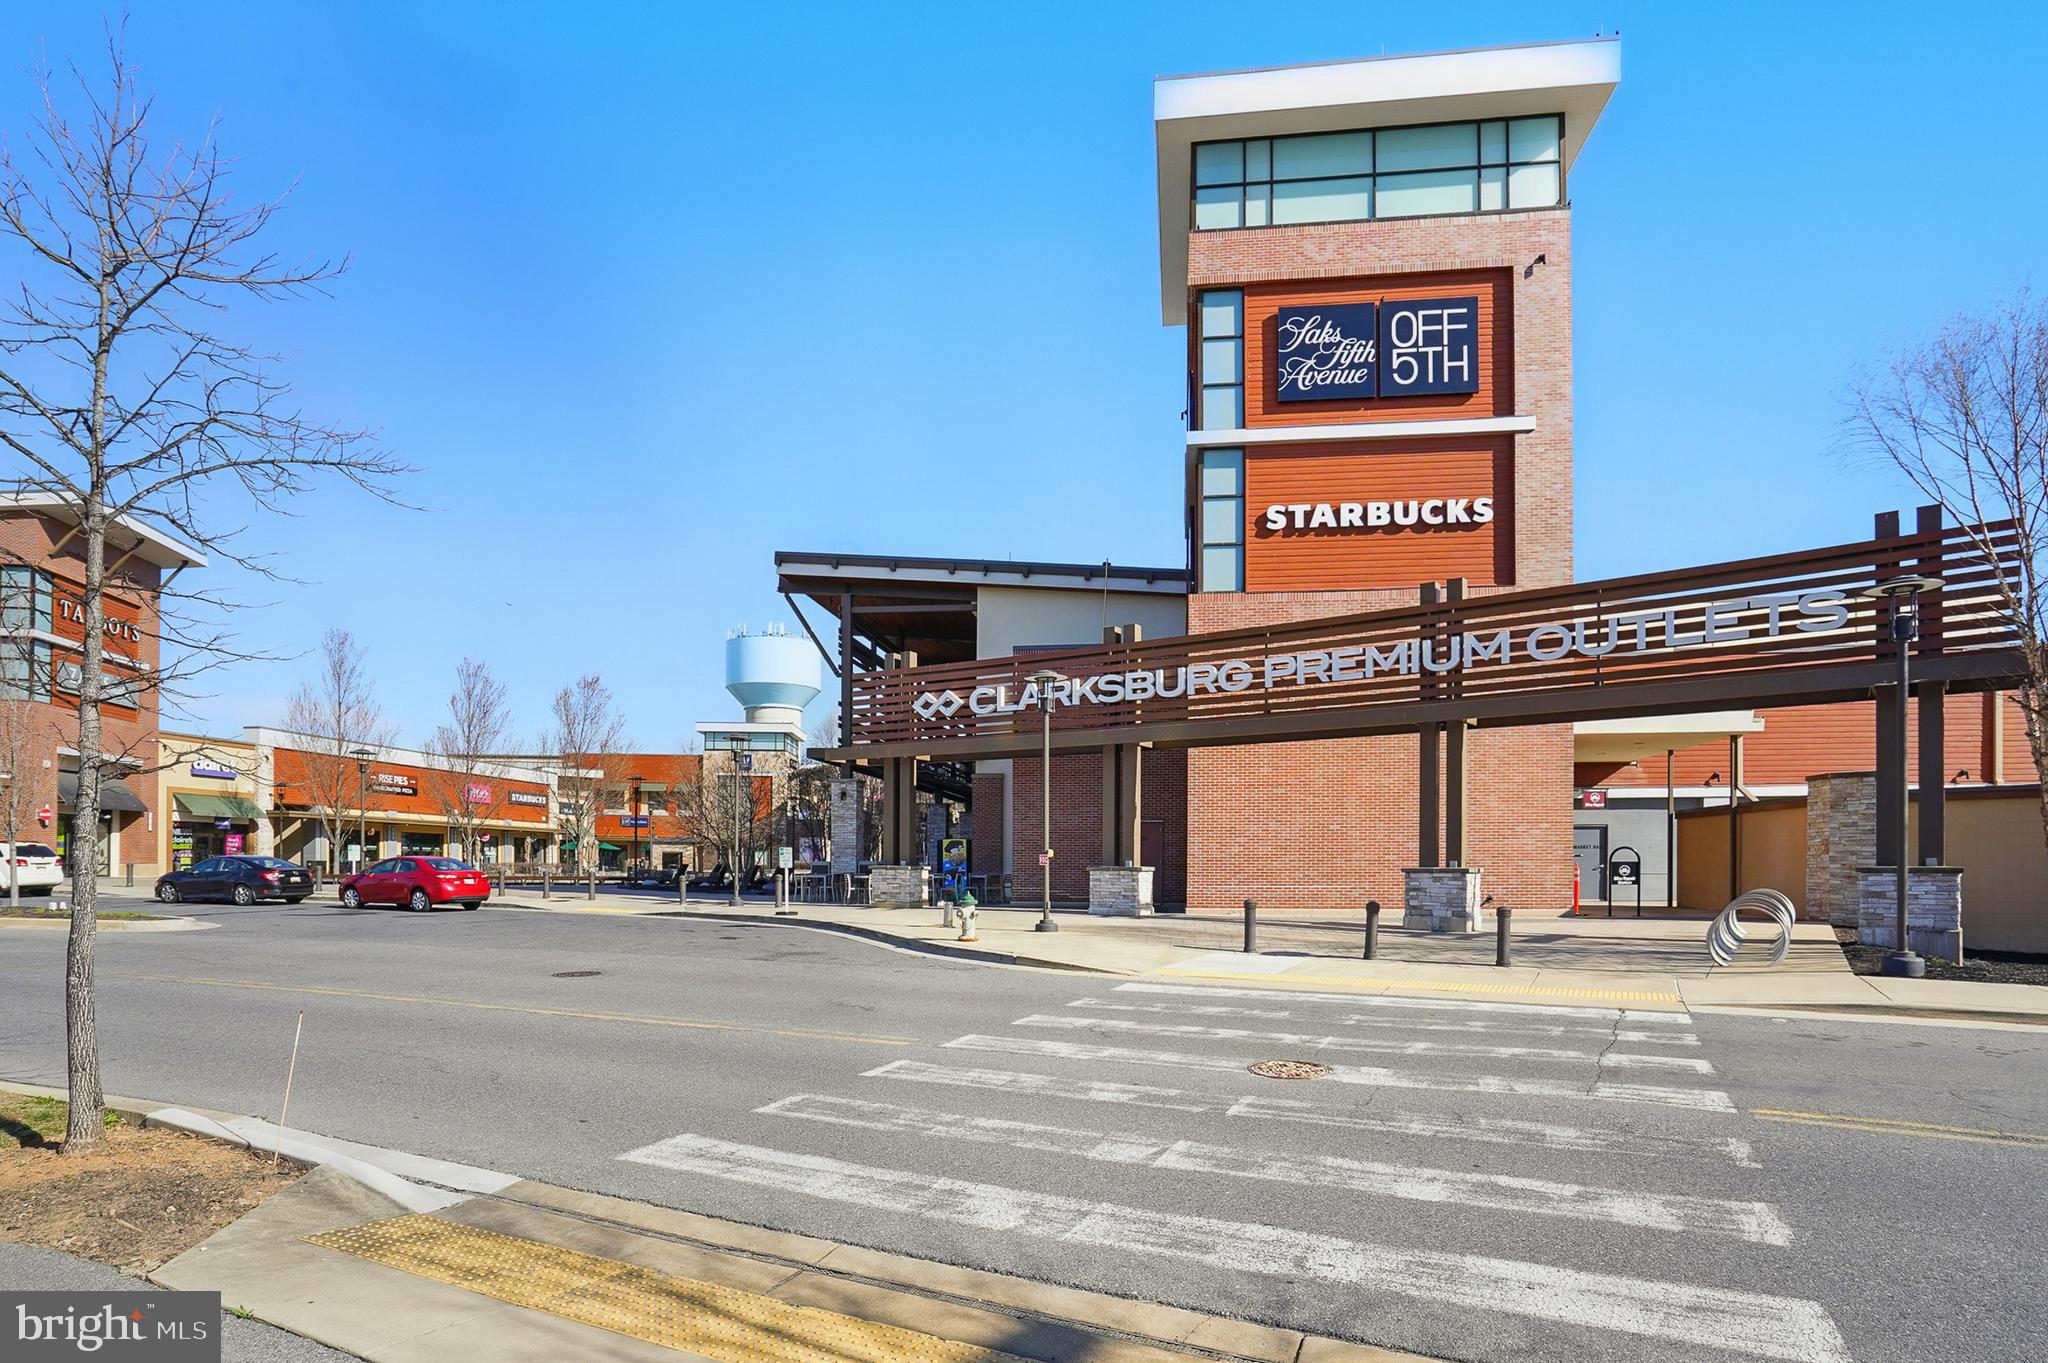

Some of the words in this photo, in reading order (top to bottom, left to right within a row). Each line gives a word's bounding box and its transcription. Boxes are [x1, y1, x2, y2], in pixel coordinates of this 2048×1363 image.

[1278, 315, 1342, 352] Saks
[1391, 308, 1467, 347] OFF
[1278, 357, 1368, 391] Avenue
[1392, 345, 1469, 385] 5TH
[1266, 497, 1495, 530] STARBUCKS
[60, 599, 140, 641] TAOTS
[969, 662, 1253, 715] CLARKSBURG
[1264, 630, 1511, 688] PREMIUM
[1526, 590, 1849, 661] OUTLETS
[512, 793, 546, 804] STARBUCKS
